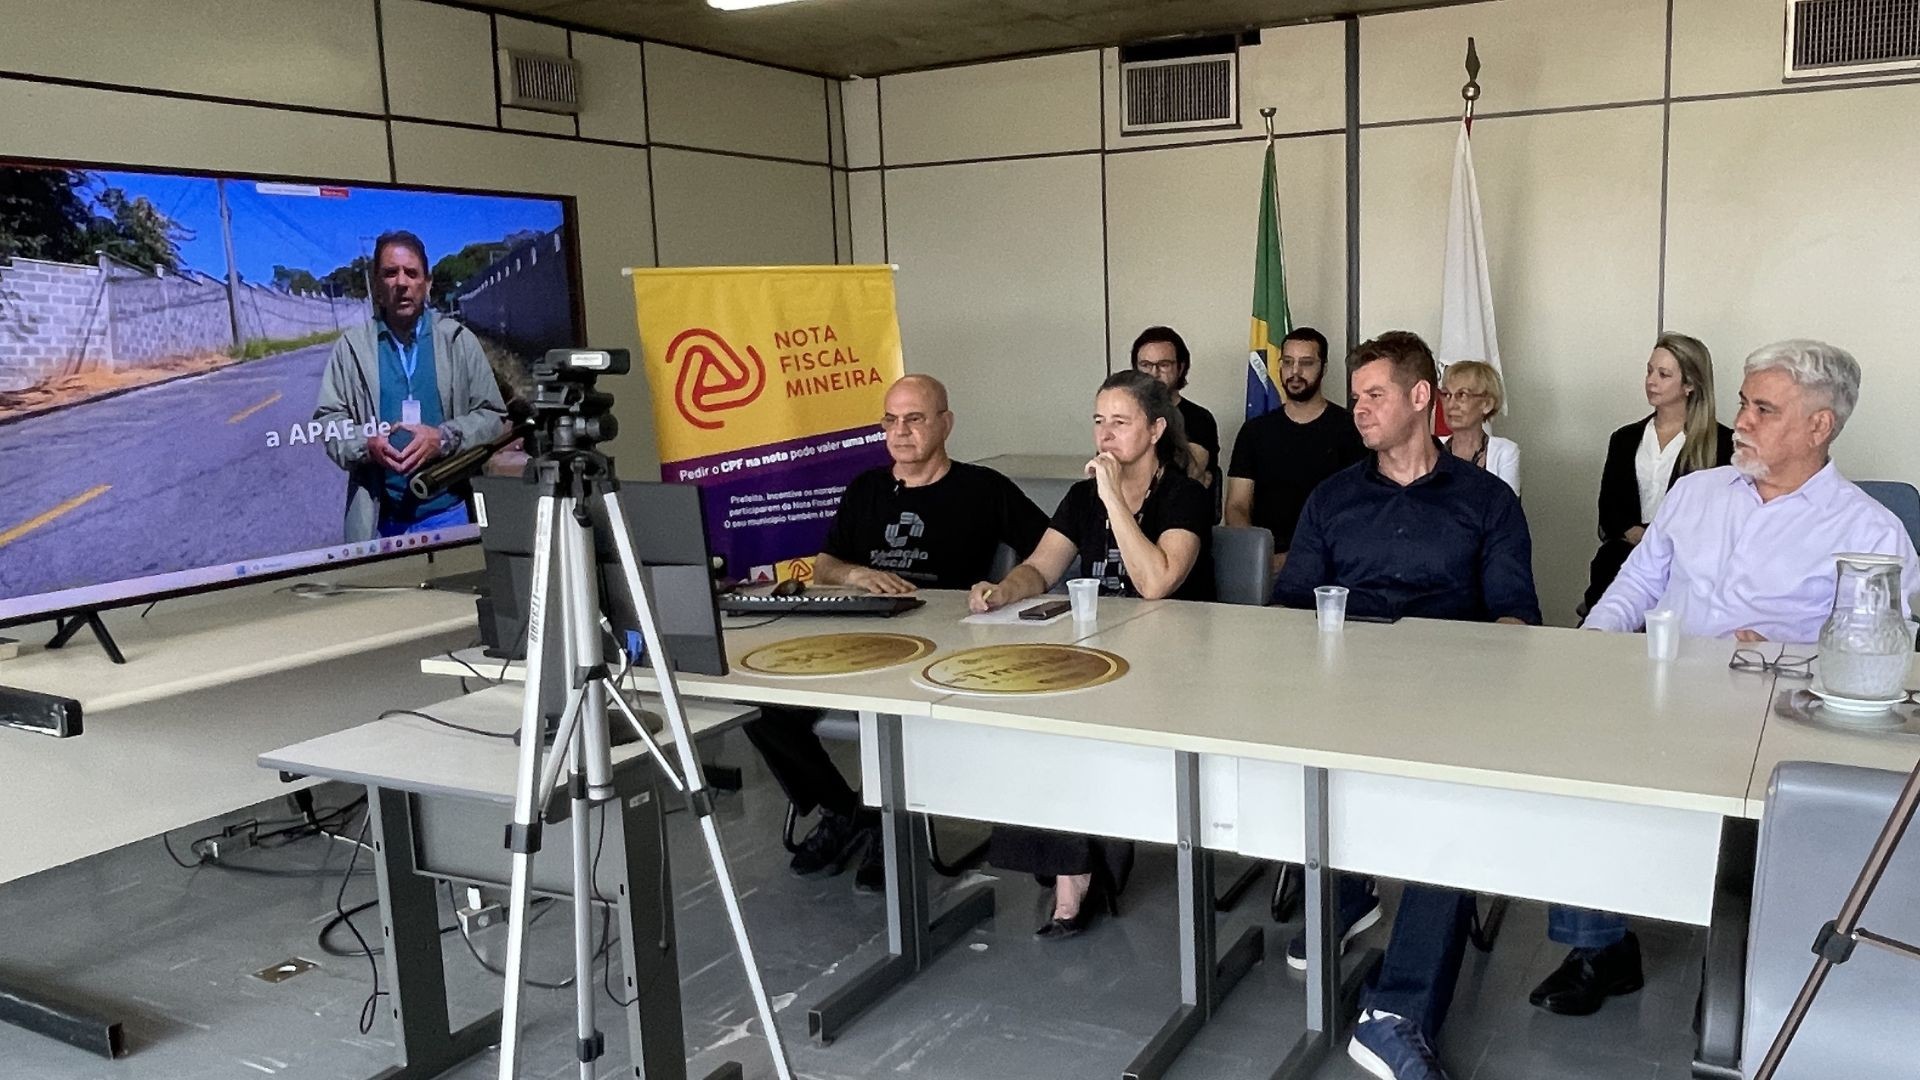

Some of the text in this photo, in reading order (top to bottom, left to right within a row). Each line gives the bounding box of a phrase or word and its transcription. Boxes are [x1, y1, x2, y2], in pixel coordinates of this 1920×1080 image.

[774, 325, 838, 349] NOTA
[780, 347, 860, 374] FISCAL
[786, 367, 883, 398] MINEIRA
[265, 416, 392, 447] a APAE de
[679, 466, 709, 482] Pedir
[711, 466, 720, 475] o
[720, 457, 744, 473] CPF
[745, 457, 761, 468] na
[761, 451, 788, 465] nota
[790, 445, 815, 461] pode
[816, 440, 840, 453] valer
[841, 436, 865, 448] uma
[792, 501, 812, 509] Nota
[812, 499, 834, 507] Fiscal
